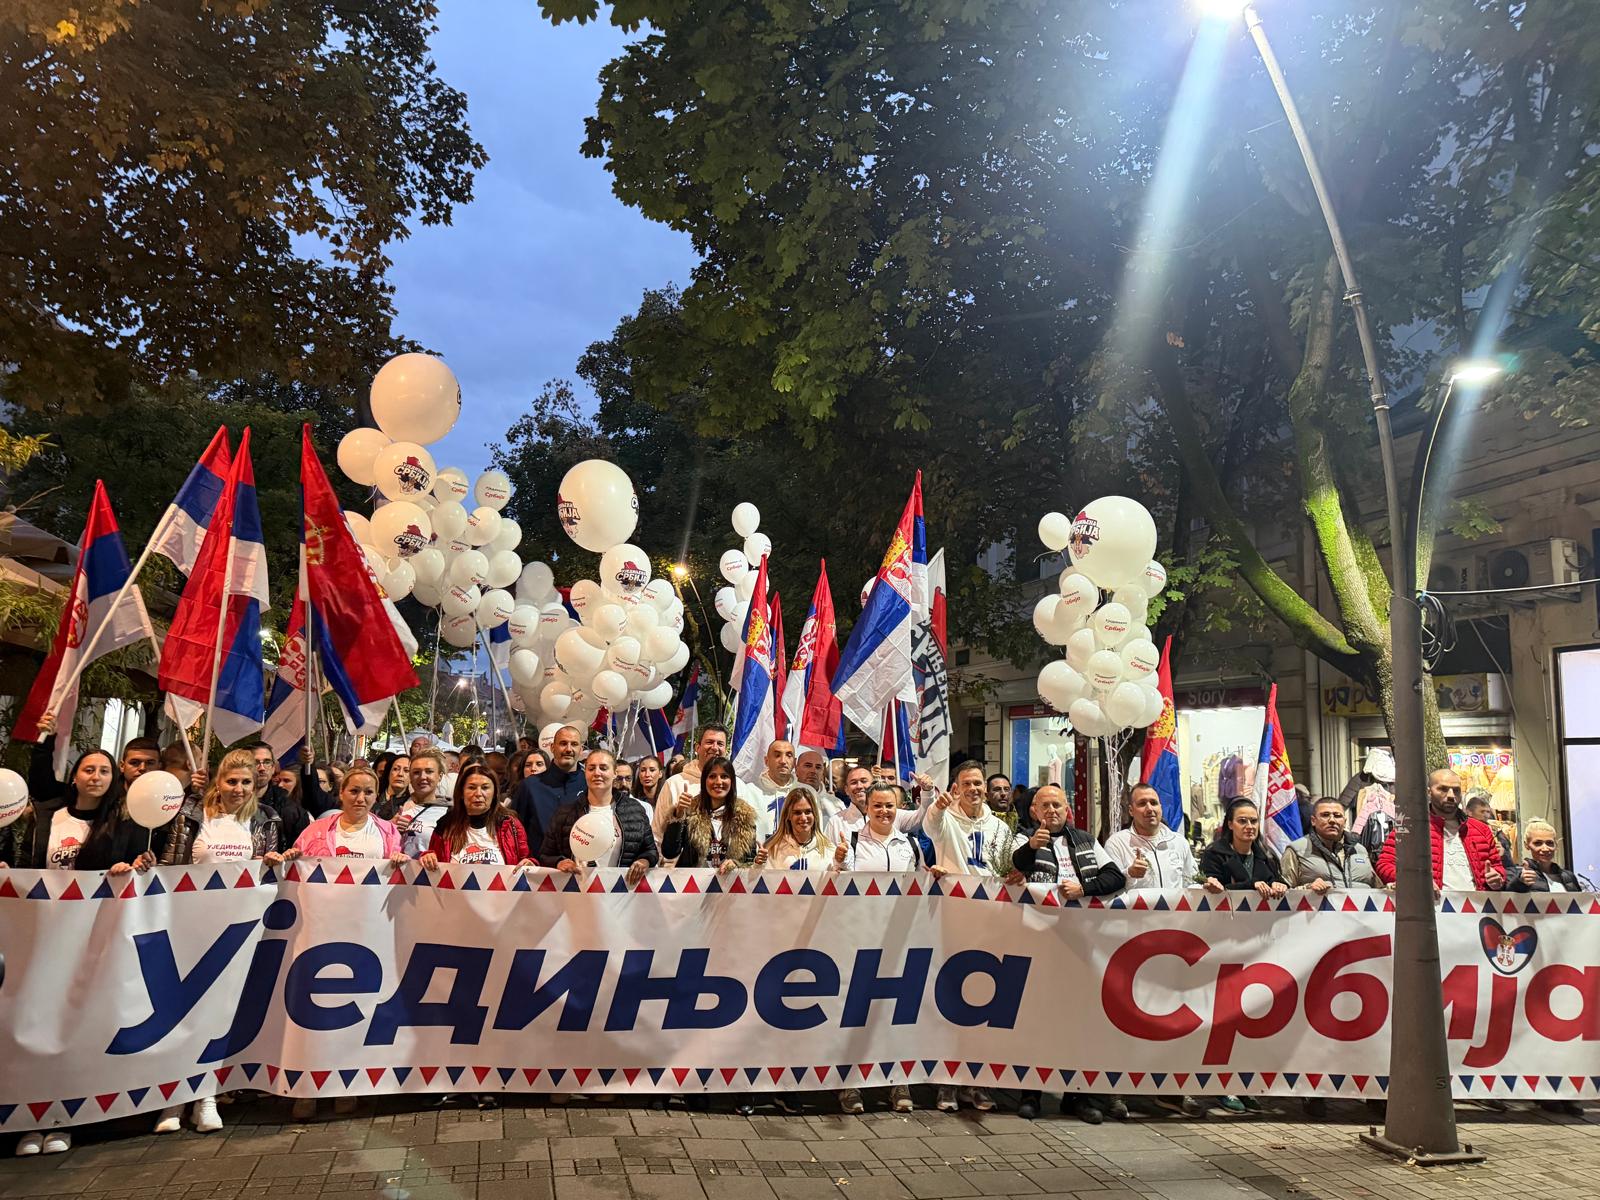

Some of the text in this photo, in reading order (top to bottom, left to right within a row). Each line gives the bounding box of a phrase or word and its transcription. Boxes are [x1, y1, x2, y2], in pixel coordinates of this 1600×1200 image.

[1187, 687, 1226, 706] Story
[51, 849, 80, 863] СРБ
[105, 899, 1032, 1064] Уједињена
